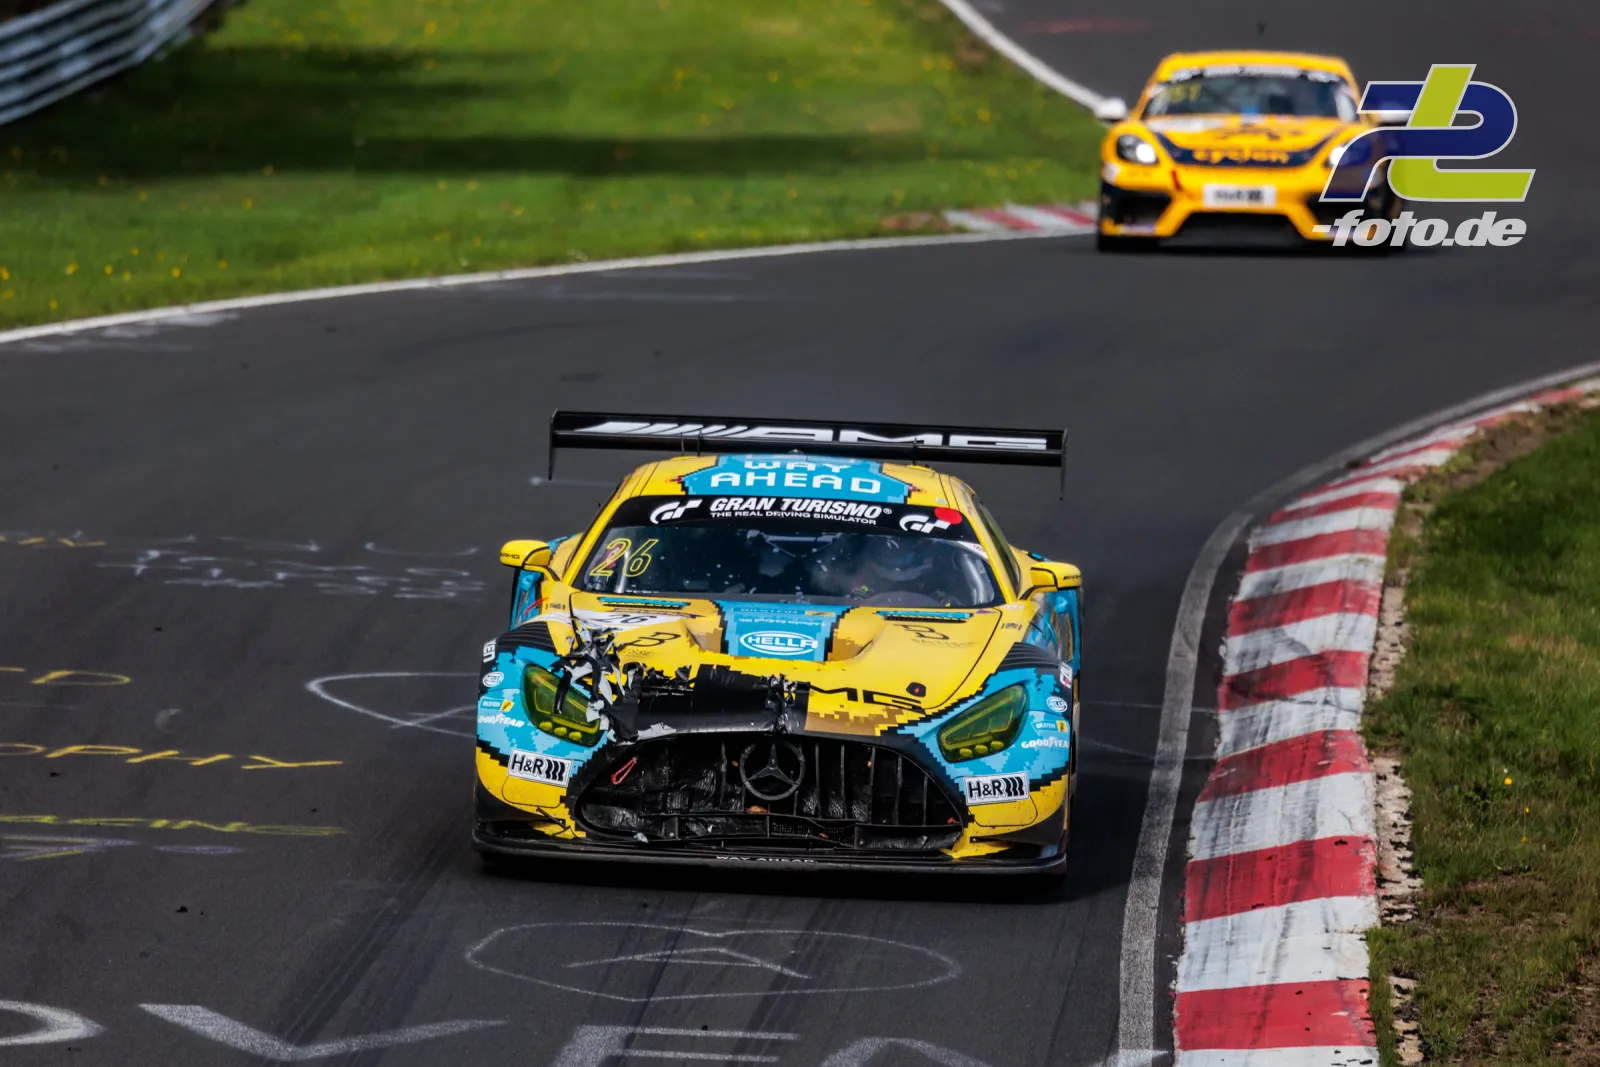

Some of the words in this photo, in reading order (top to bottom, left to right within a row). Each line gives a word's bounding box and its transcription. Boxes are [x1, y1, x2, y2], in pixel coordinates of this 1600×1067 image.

[744, 461, 848, 473] WAY
[711, 472, 881, 494] AHEAD
[709, 498, 776, 513] GRAN
[813, 515, 877, 525] SIMULATOR
[589, 538, 659, 577] 26
[747, 636, 819, 649] HELLA
[1021, 736, 1069, 749] GOODYEA
